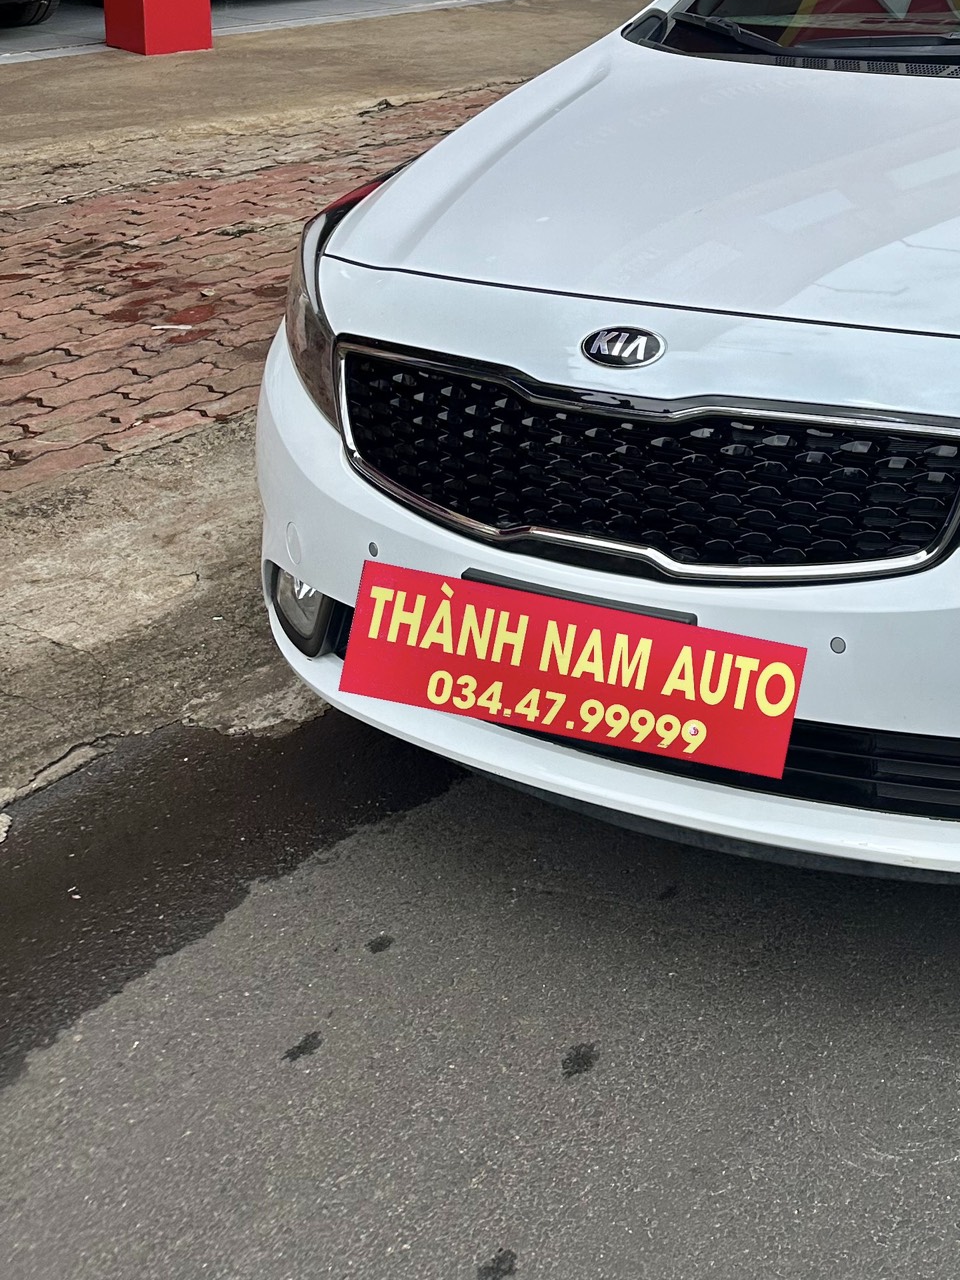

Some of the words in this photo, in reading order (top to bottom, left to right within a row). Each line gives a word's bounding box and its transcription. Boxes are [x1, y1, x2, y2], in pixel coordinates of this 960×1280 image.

[588, 337, 647, 361] KIA
[367, 582, 530, 668] THÀNH
[539, 620, 652, 691] NAM
[660, 646, 796, 718] AUTO
[426, 669, 707, 756] 034.47.99999
